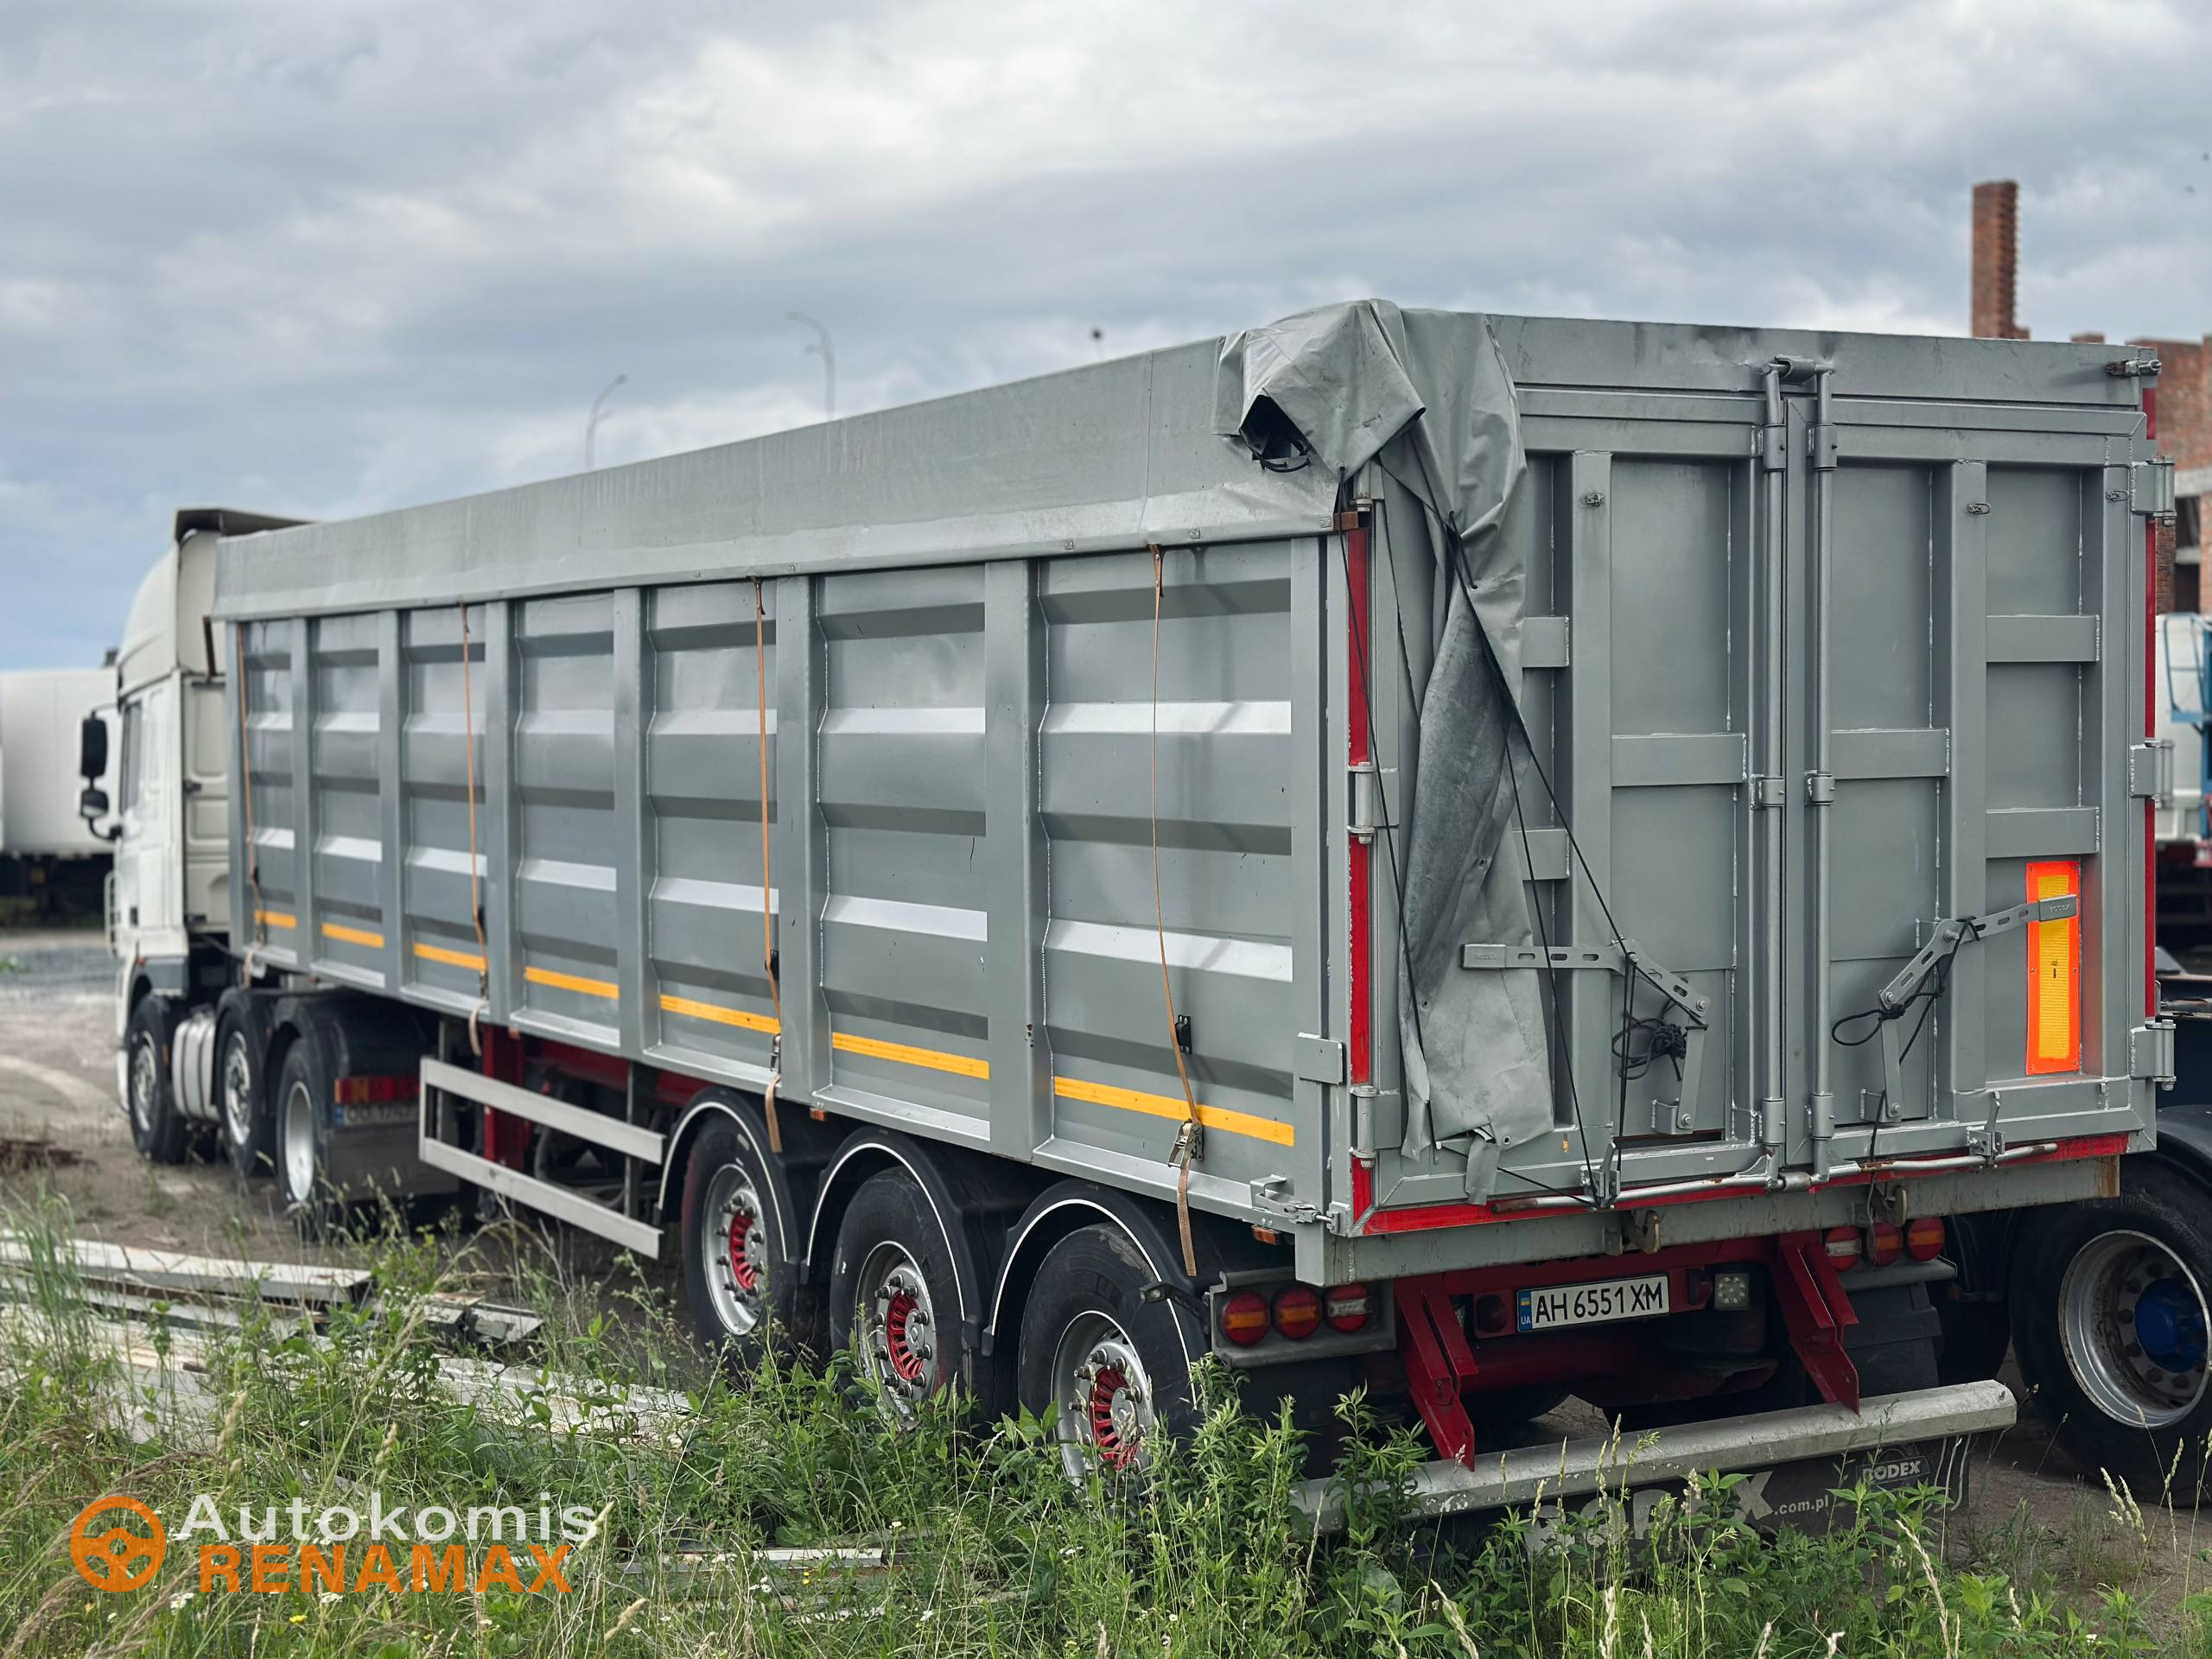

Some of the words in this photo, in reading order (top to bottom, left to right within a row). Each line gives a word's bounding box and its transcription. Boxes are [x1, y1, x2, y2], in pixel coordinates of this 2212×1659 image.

[1535, 1293, 1568, 1323] AH
[1573, 1287, 1624, 1318] 6551
[1630, 1281, 1662, 1312] XM
[1521, 1315, 1532, 1325] UA
